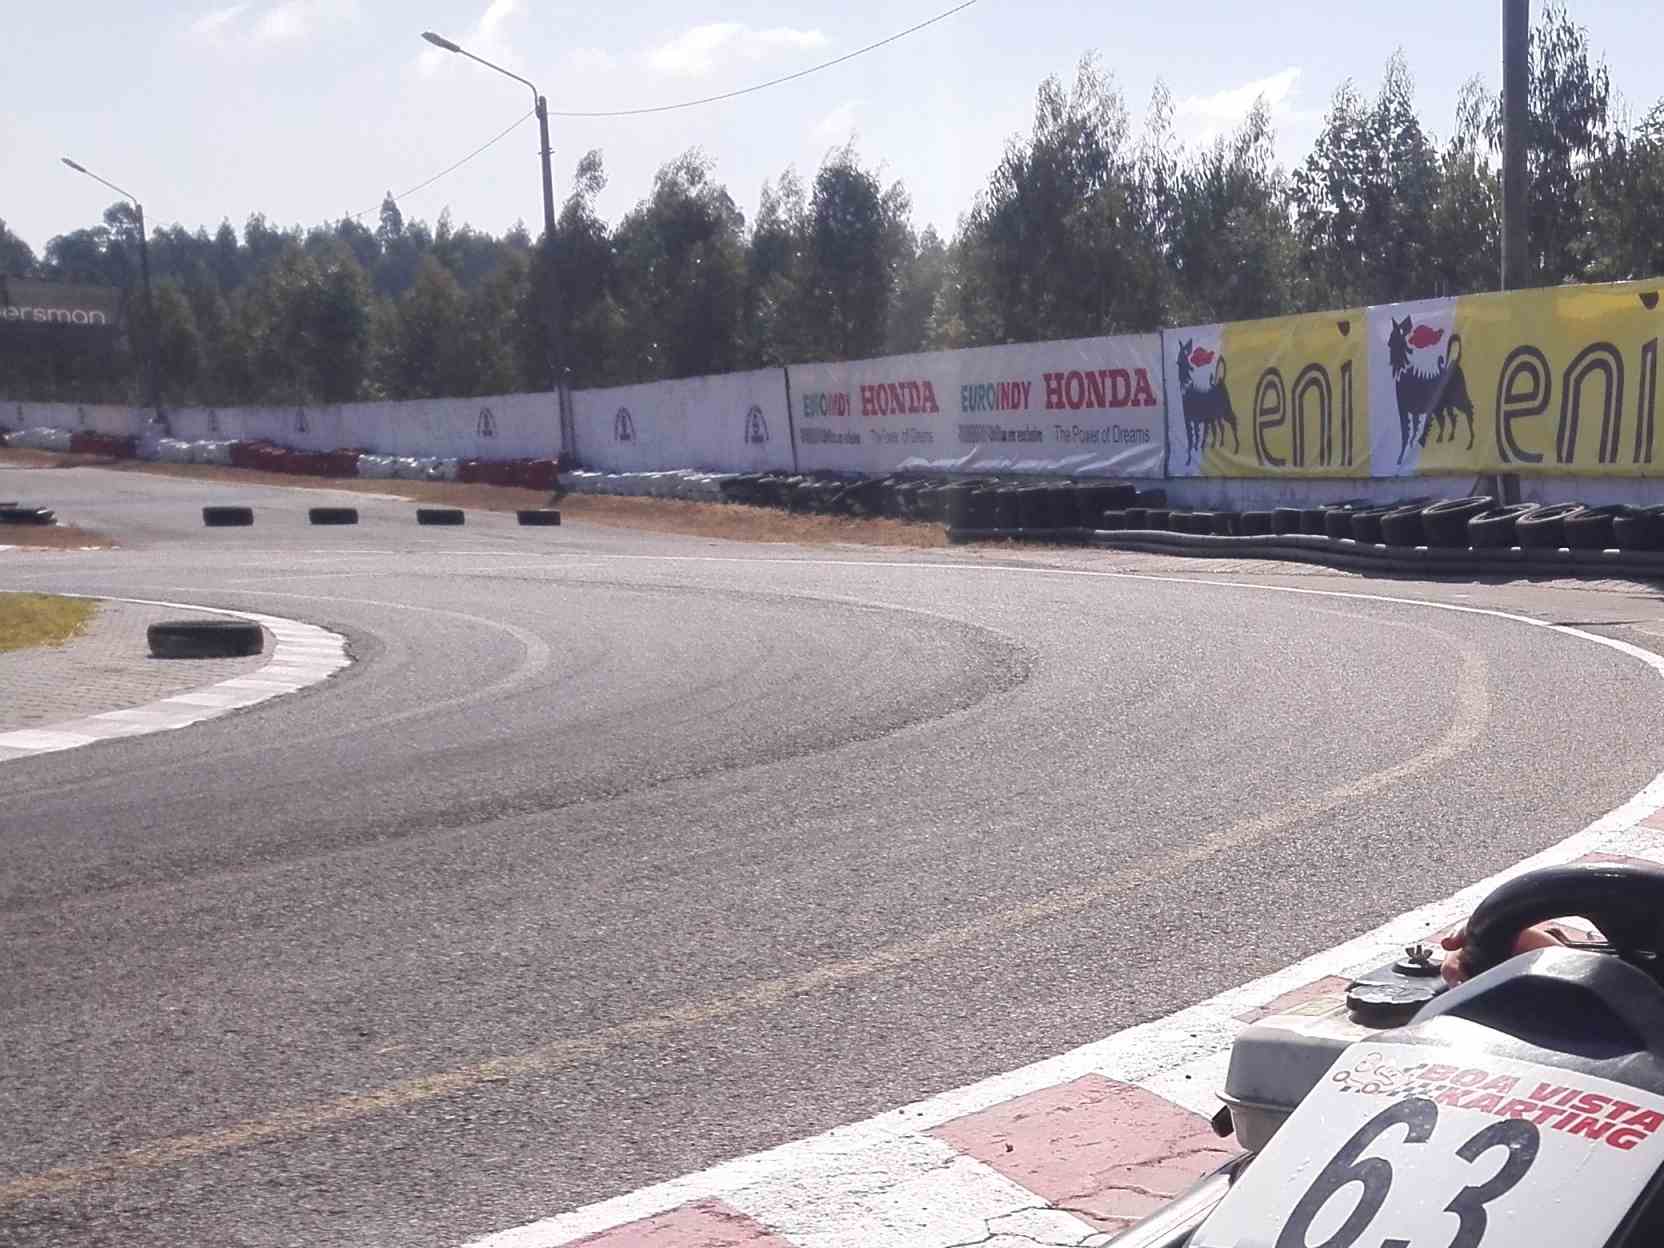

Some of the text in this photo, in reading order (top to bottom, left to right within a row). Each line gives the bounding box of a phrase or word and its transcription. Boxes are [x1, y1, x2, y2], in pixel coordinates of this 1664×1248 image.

[860, 380, 939, 416] HONDA
[961, 368, 1157, 412] EUROINDY HONDA
[1253, 319, 1353, 468] eni
[1496, 290, 1659, 463] eni
[1112, 425, 1150, 443] Dreams
[1419, 1063, 1521, 1094] BOA
[1433, 1087, 1648, 1150] KARTING
